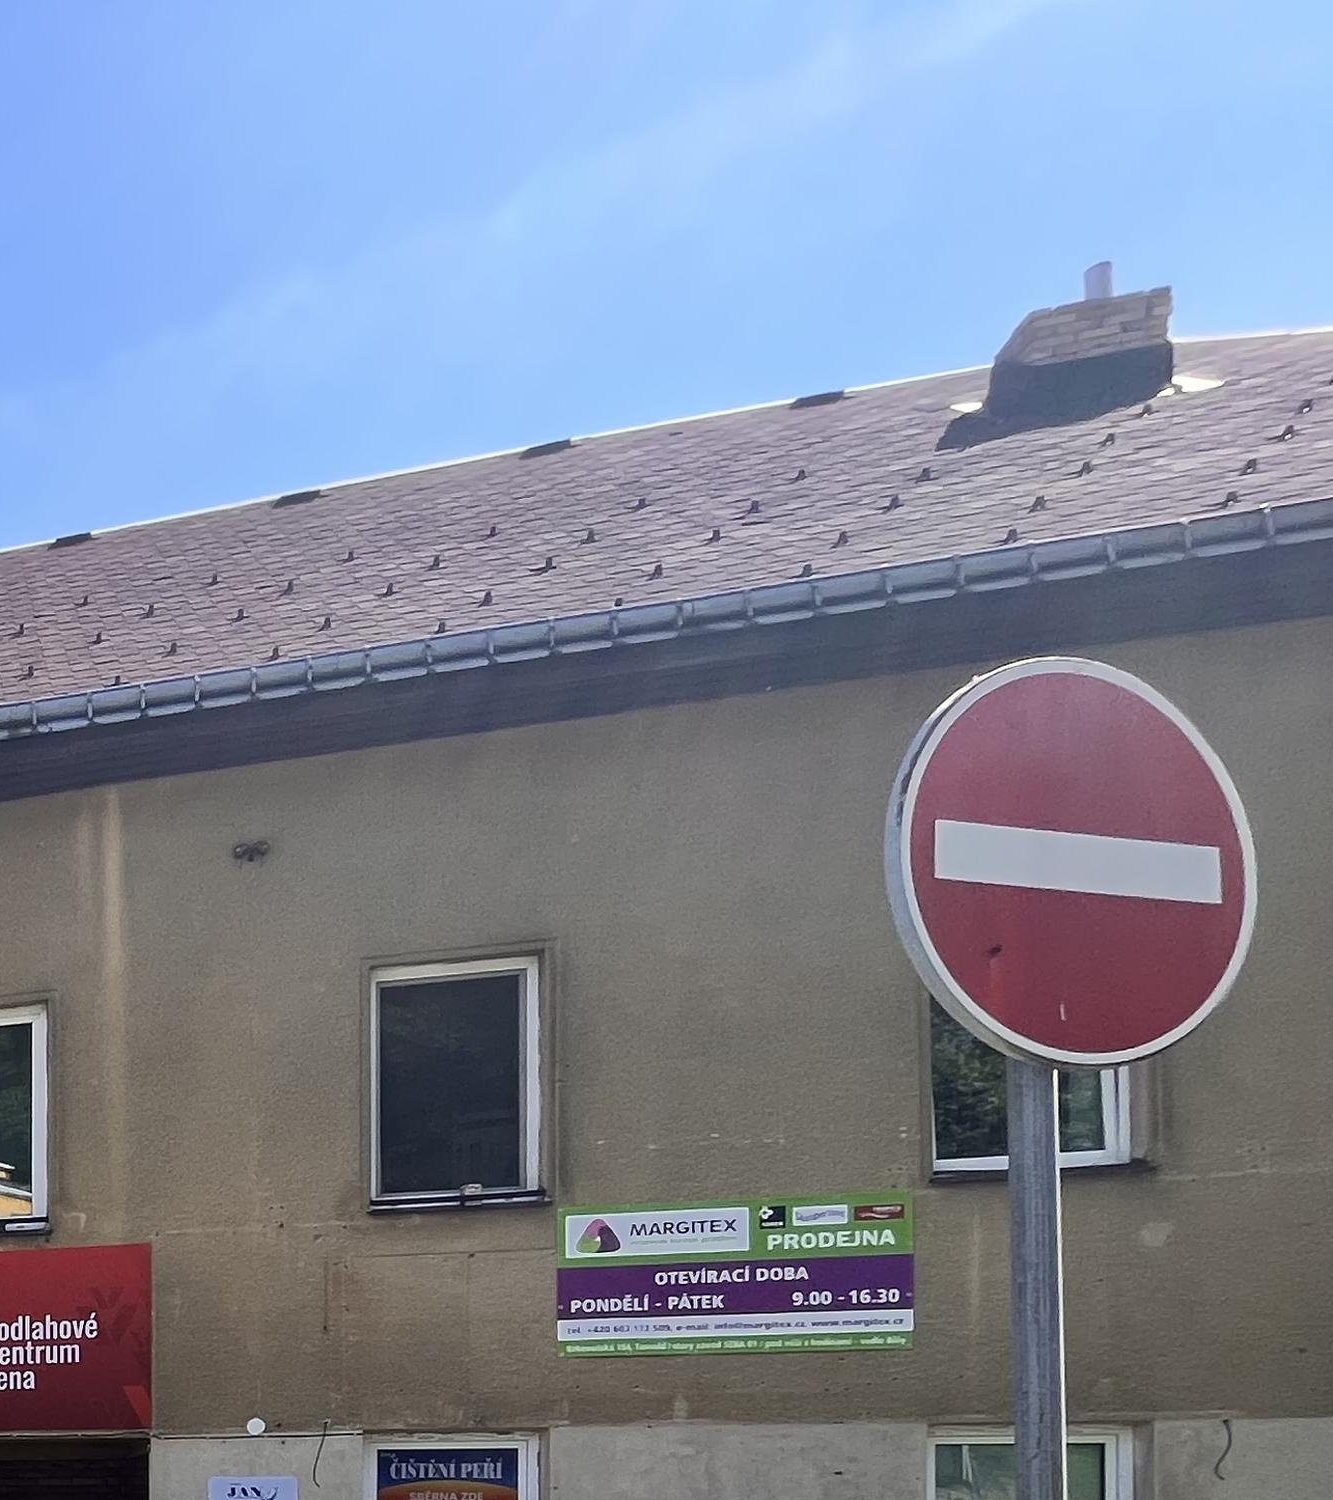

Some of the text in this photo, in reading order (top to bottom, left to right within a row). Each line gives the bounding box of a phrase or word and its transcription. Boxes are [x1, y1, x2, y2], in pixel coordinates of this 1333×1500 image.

[630, 1219, 737, 1237] MARGITEX
[767, 1229, 895, 1251] PRODEJNA
[654, 1265, 809, 1286] OTEVÍRACÍ DOBA
[570, 1293, 649, 1313] PONDĚLÍ
[667, 1292, 725, 1310] PÁTEK
[791, 1291, 832, 1306] 9.00
[848, 1288, 901, 1304] 16.30
[389, 1457, 503, 1480] ČIŠTĚNÍ PEŘÍ
[461, 1492, 484, 1500] ZDE
